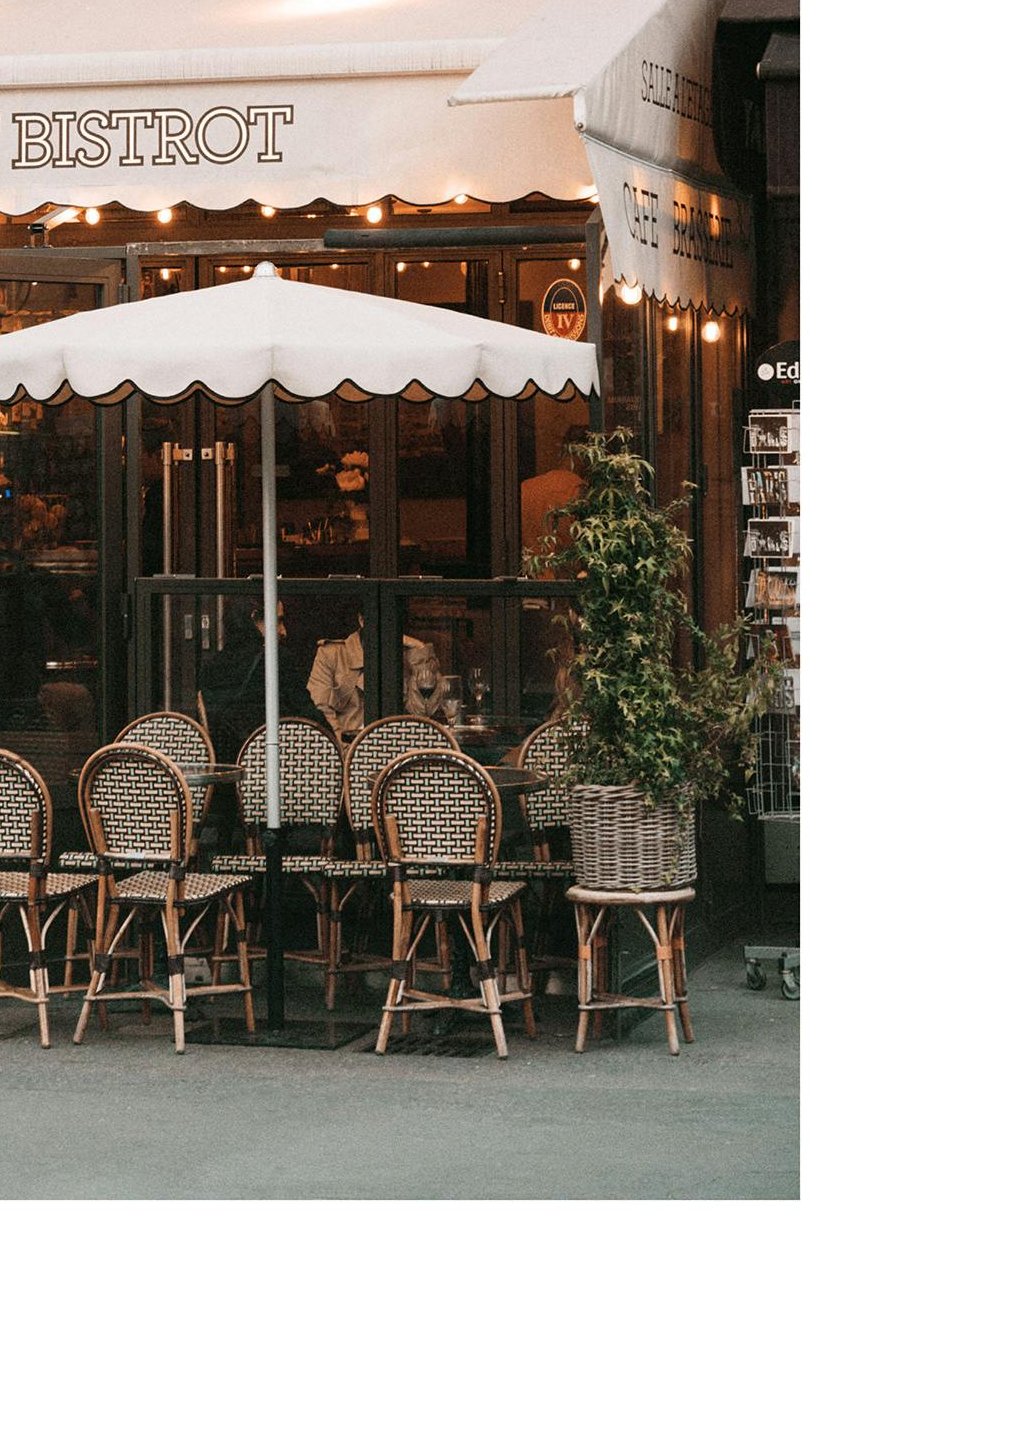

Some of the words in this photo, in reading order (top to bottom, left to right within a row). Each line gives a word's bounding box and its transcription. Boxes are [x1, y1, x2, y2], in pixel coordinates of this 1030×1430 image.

[11, 105, 294, 169] BISTROT
[623, 181, 658, 248] CAFE
[672, 200, 733, 268] BRASSERIE
[557, 313, 575, 329] IV
